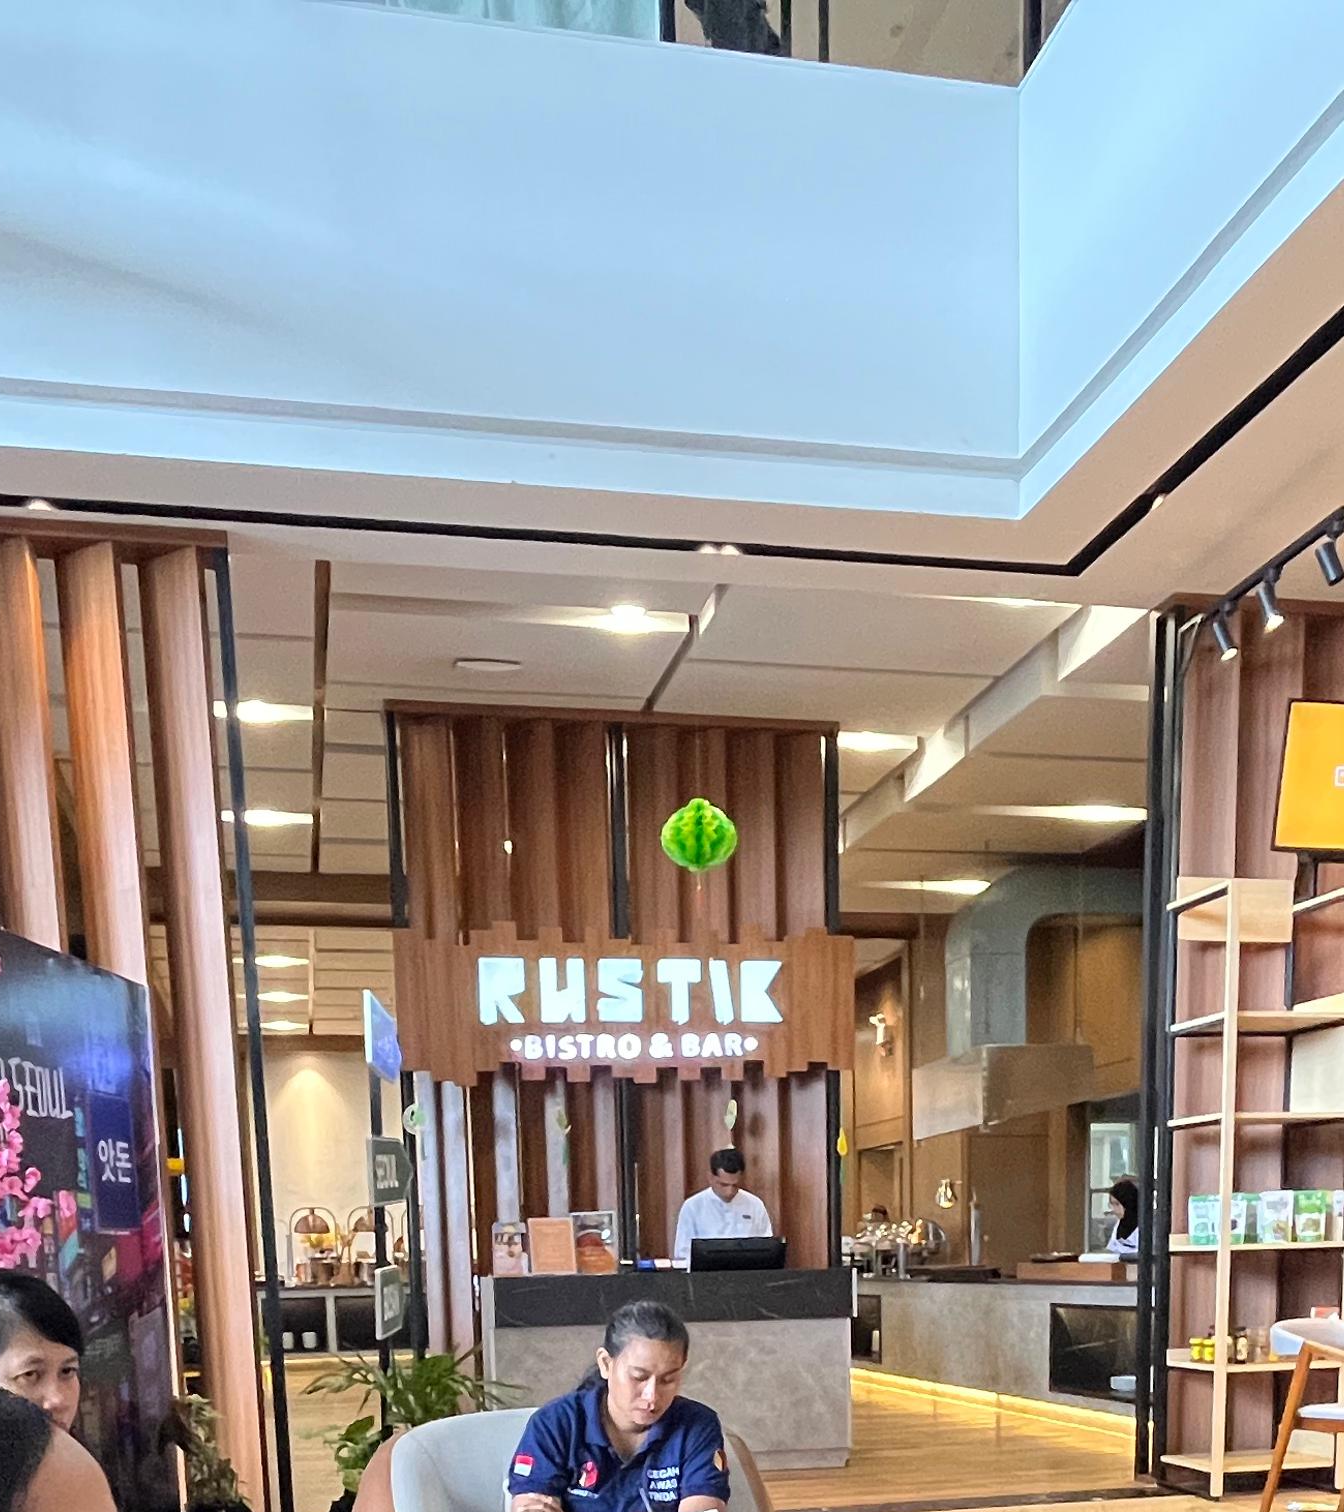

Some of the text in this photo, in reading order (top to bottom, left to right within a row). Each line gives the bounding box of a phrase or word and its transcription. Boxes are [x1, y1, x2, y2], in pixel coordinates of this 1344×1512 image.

[477, 956, 784, 1026] RUSTIK
[524, 1032, 744, 1060] BISTRO & BAR
[8, 1056, 74, 1119] SEOUL
[647, 1466, 680, 1479] CEGAH
[649, 1478, 678, 1490] AWAS
[648, 1490, 678, 1502] TINDA
